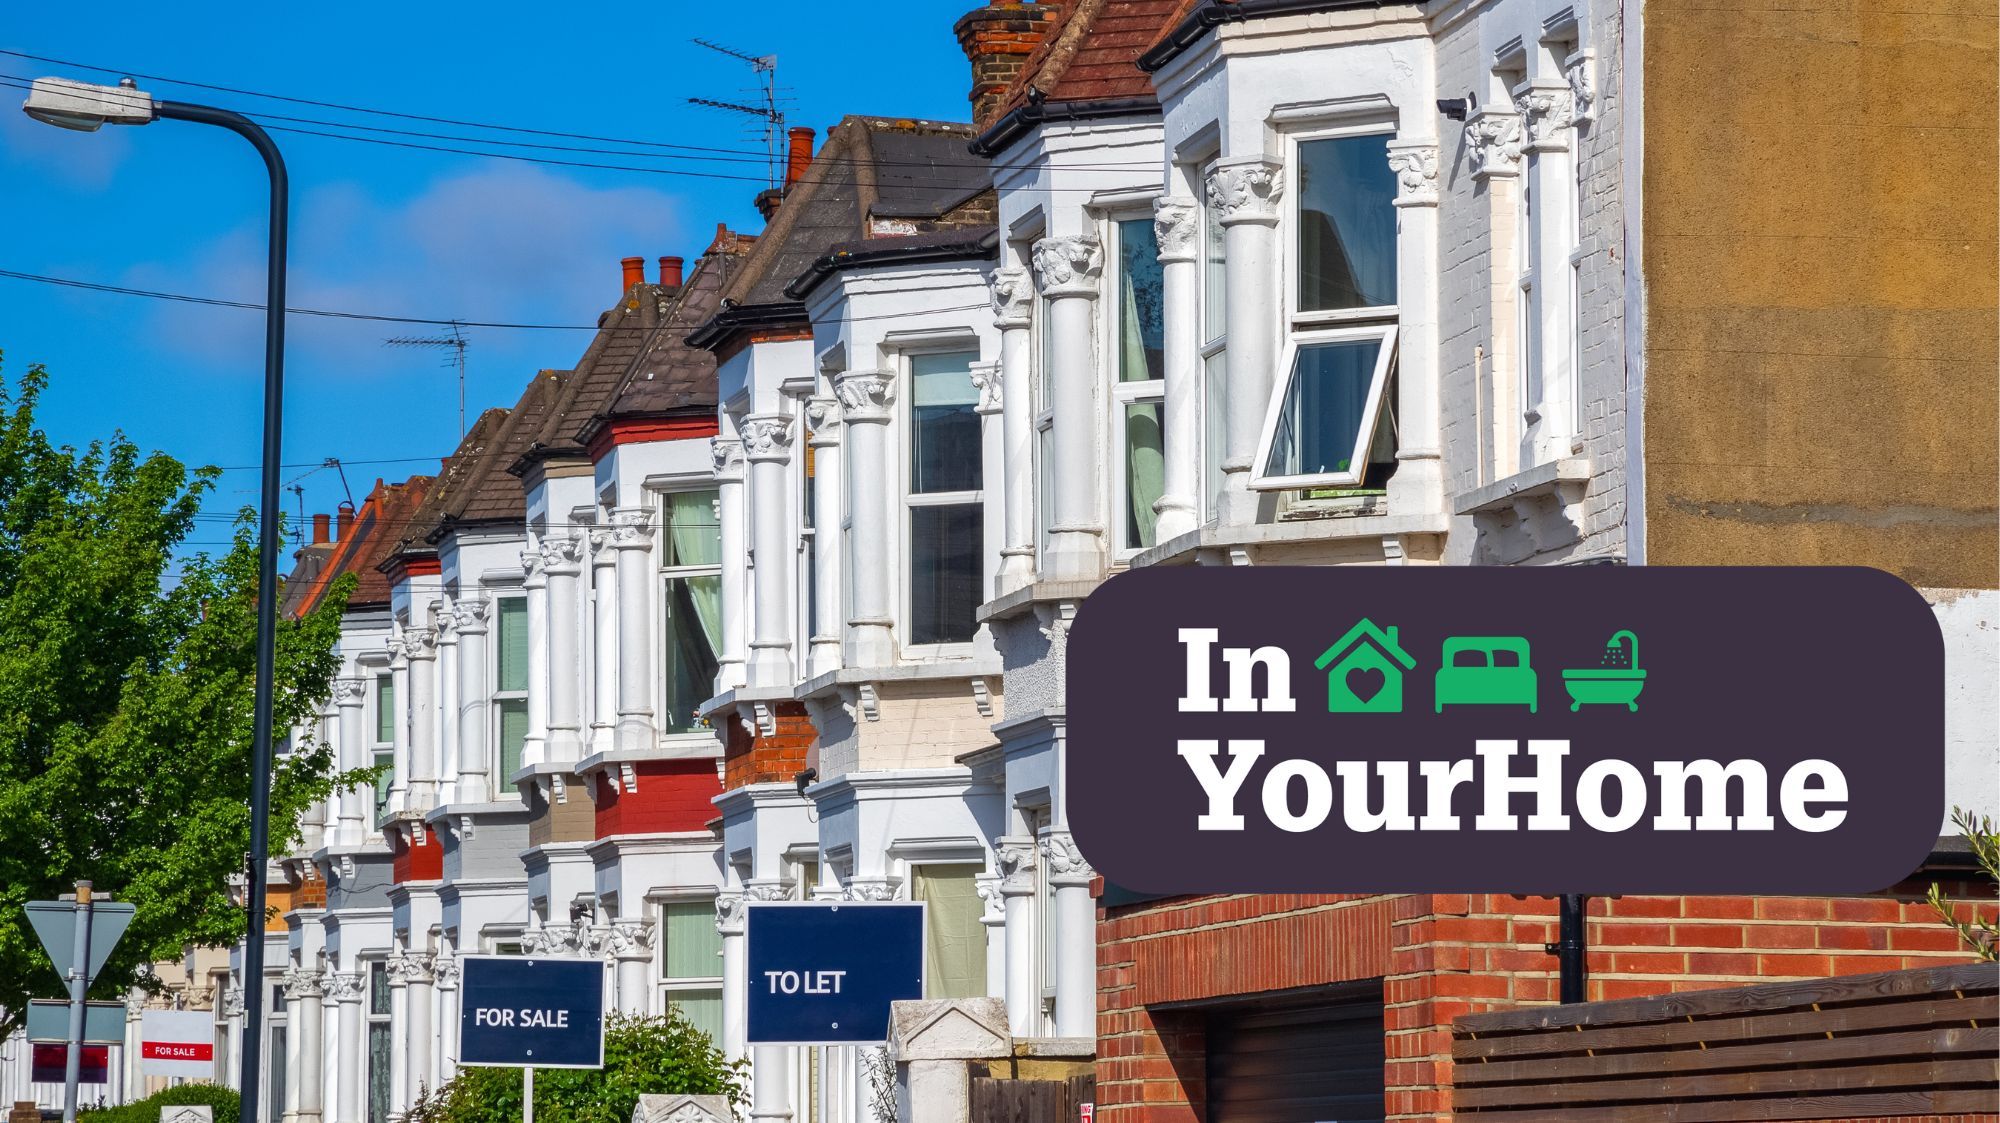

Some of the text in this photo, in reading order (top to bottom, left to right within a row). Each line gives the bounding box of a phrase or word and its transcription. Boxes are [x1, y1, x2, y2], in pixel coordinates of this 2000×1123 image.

[765, 971, 846, 993] TO LET
[475, 1008, 569, 1028] FOR SALE
[155, 1046, 195, 1057] FOR SALE
